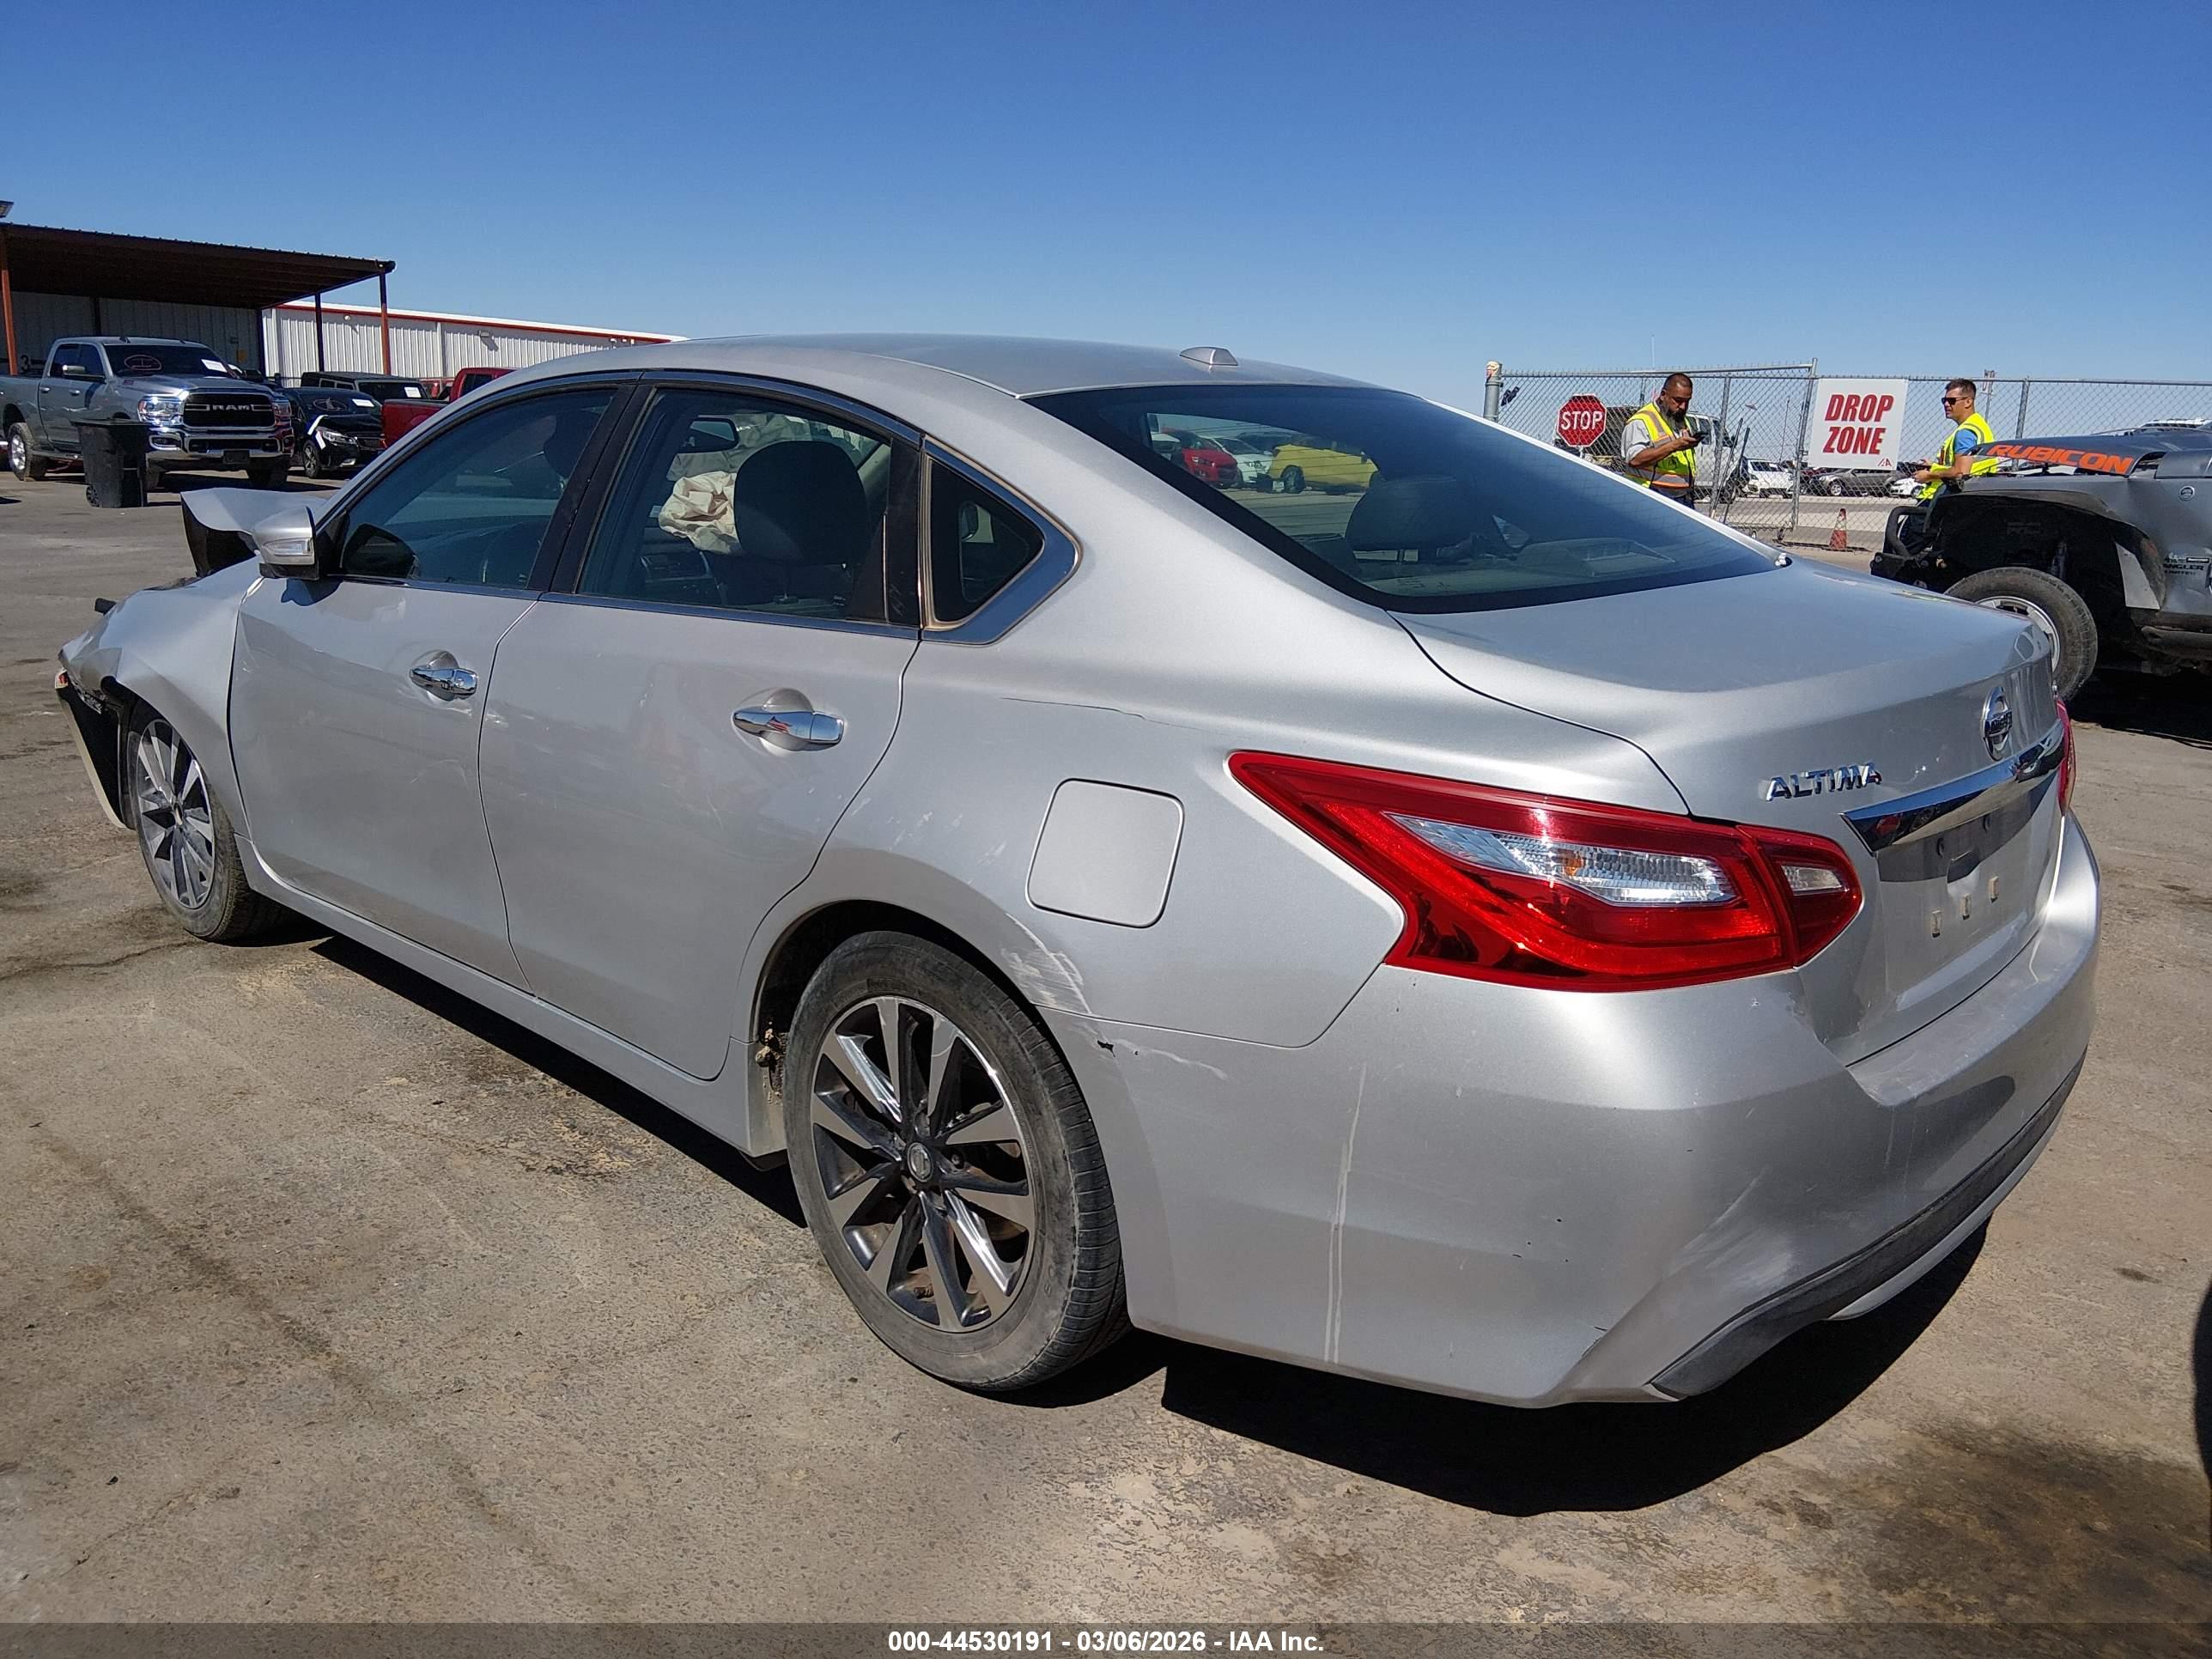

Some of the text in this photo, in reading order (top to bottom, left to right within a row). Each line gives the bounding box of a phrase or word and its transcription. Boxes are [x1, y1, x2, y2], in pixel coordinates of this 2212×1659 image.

[1561, 410, 1603, 430] STOP
[1825, 394, 1893, 422] DROP
[1822, 427, 1887, 454] ZONE
[1986, 444, 2135, 475] RUBICON
[1765, 762, 1882, 801] ALTIMA
